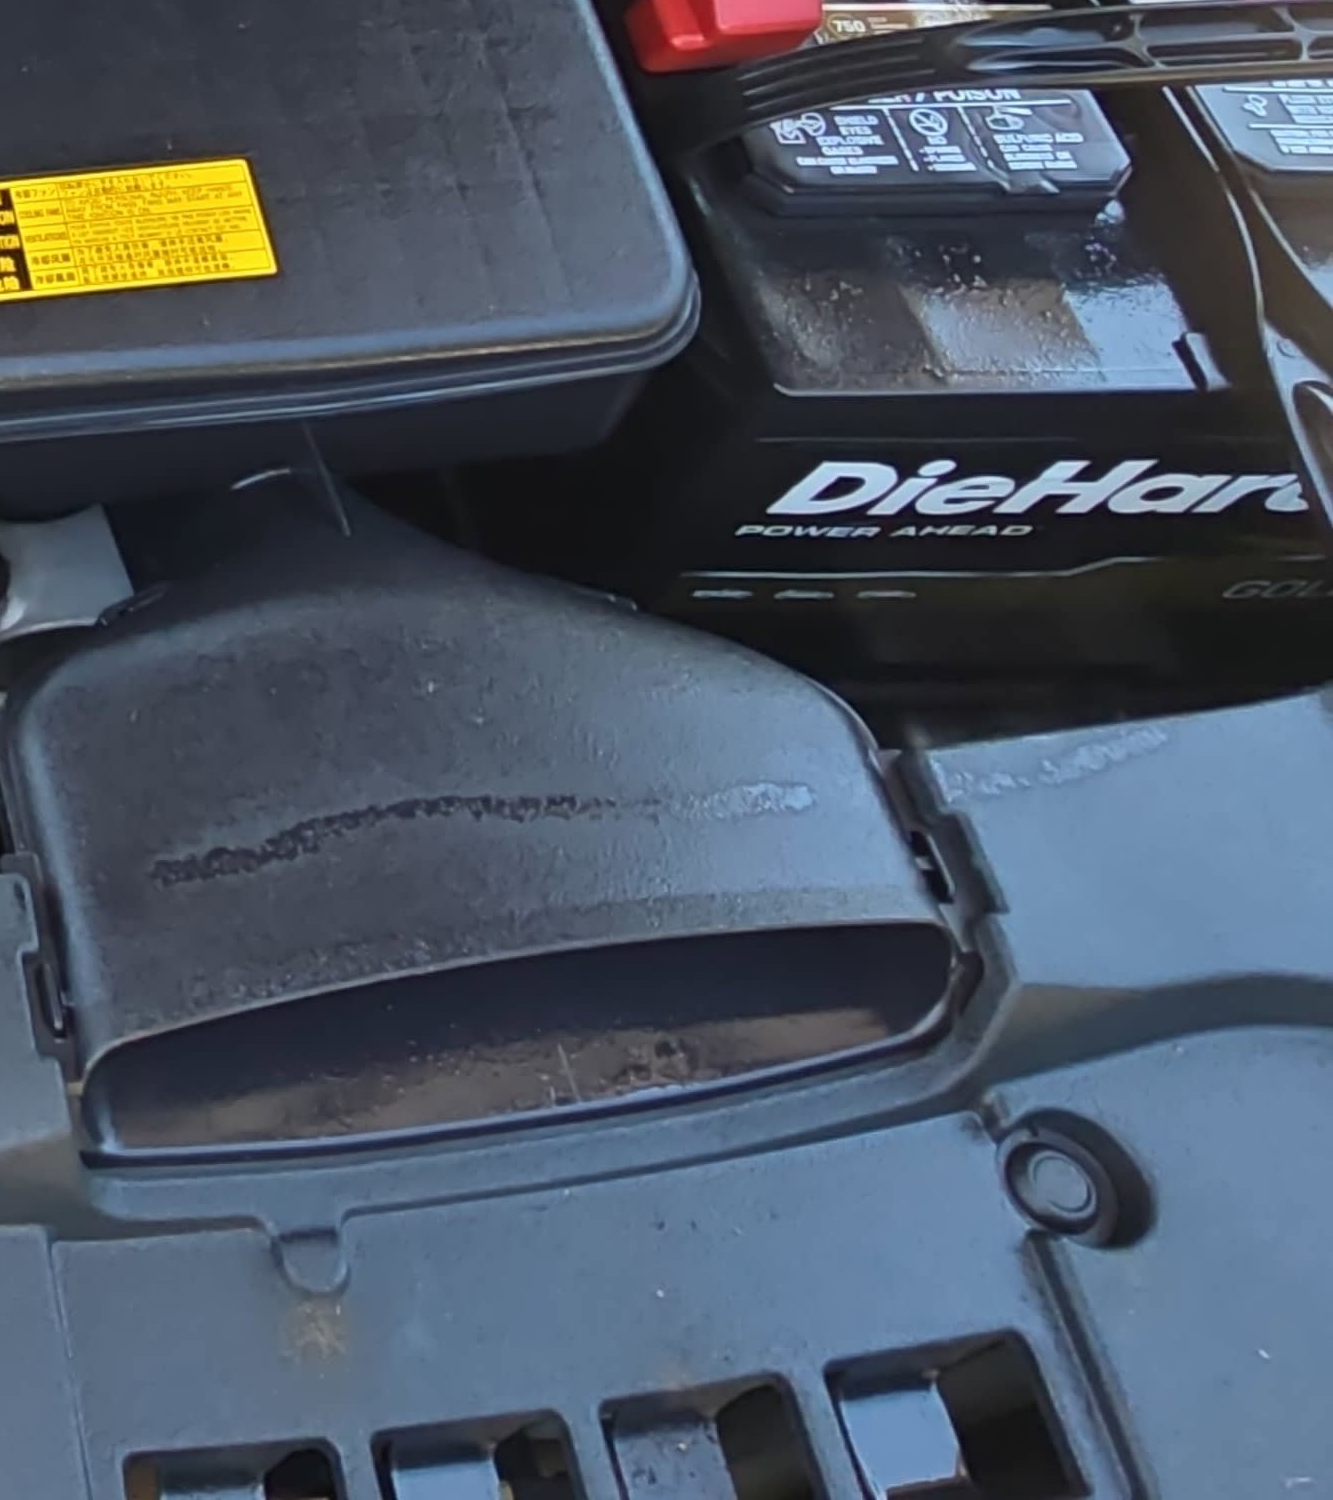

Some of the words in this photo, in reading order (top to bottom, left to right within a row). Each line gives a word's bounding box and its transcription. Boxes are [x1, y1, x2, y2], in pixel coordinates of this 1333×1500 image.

[831, 19, 866, 33] 750
[735, 524, 880, 538] POWER
[889, 524, 1033, 538] AHEAD
[1221, 579, 1333, 599] GOL
